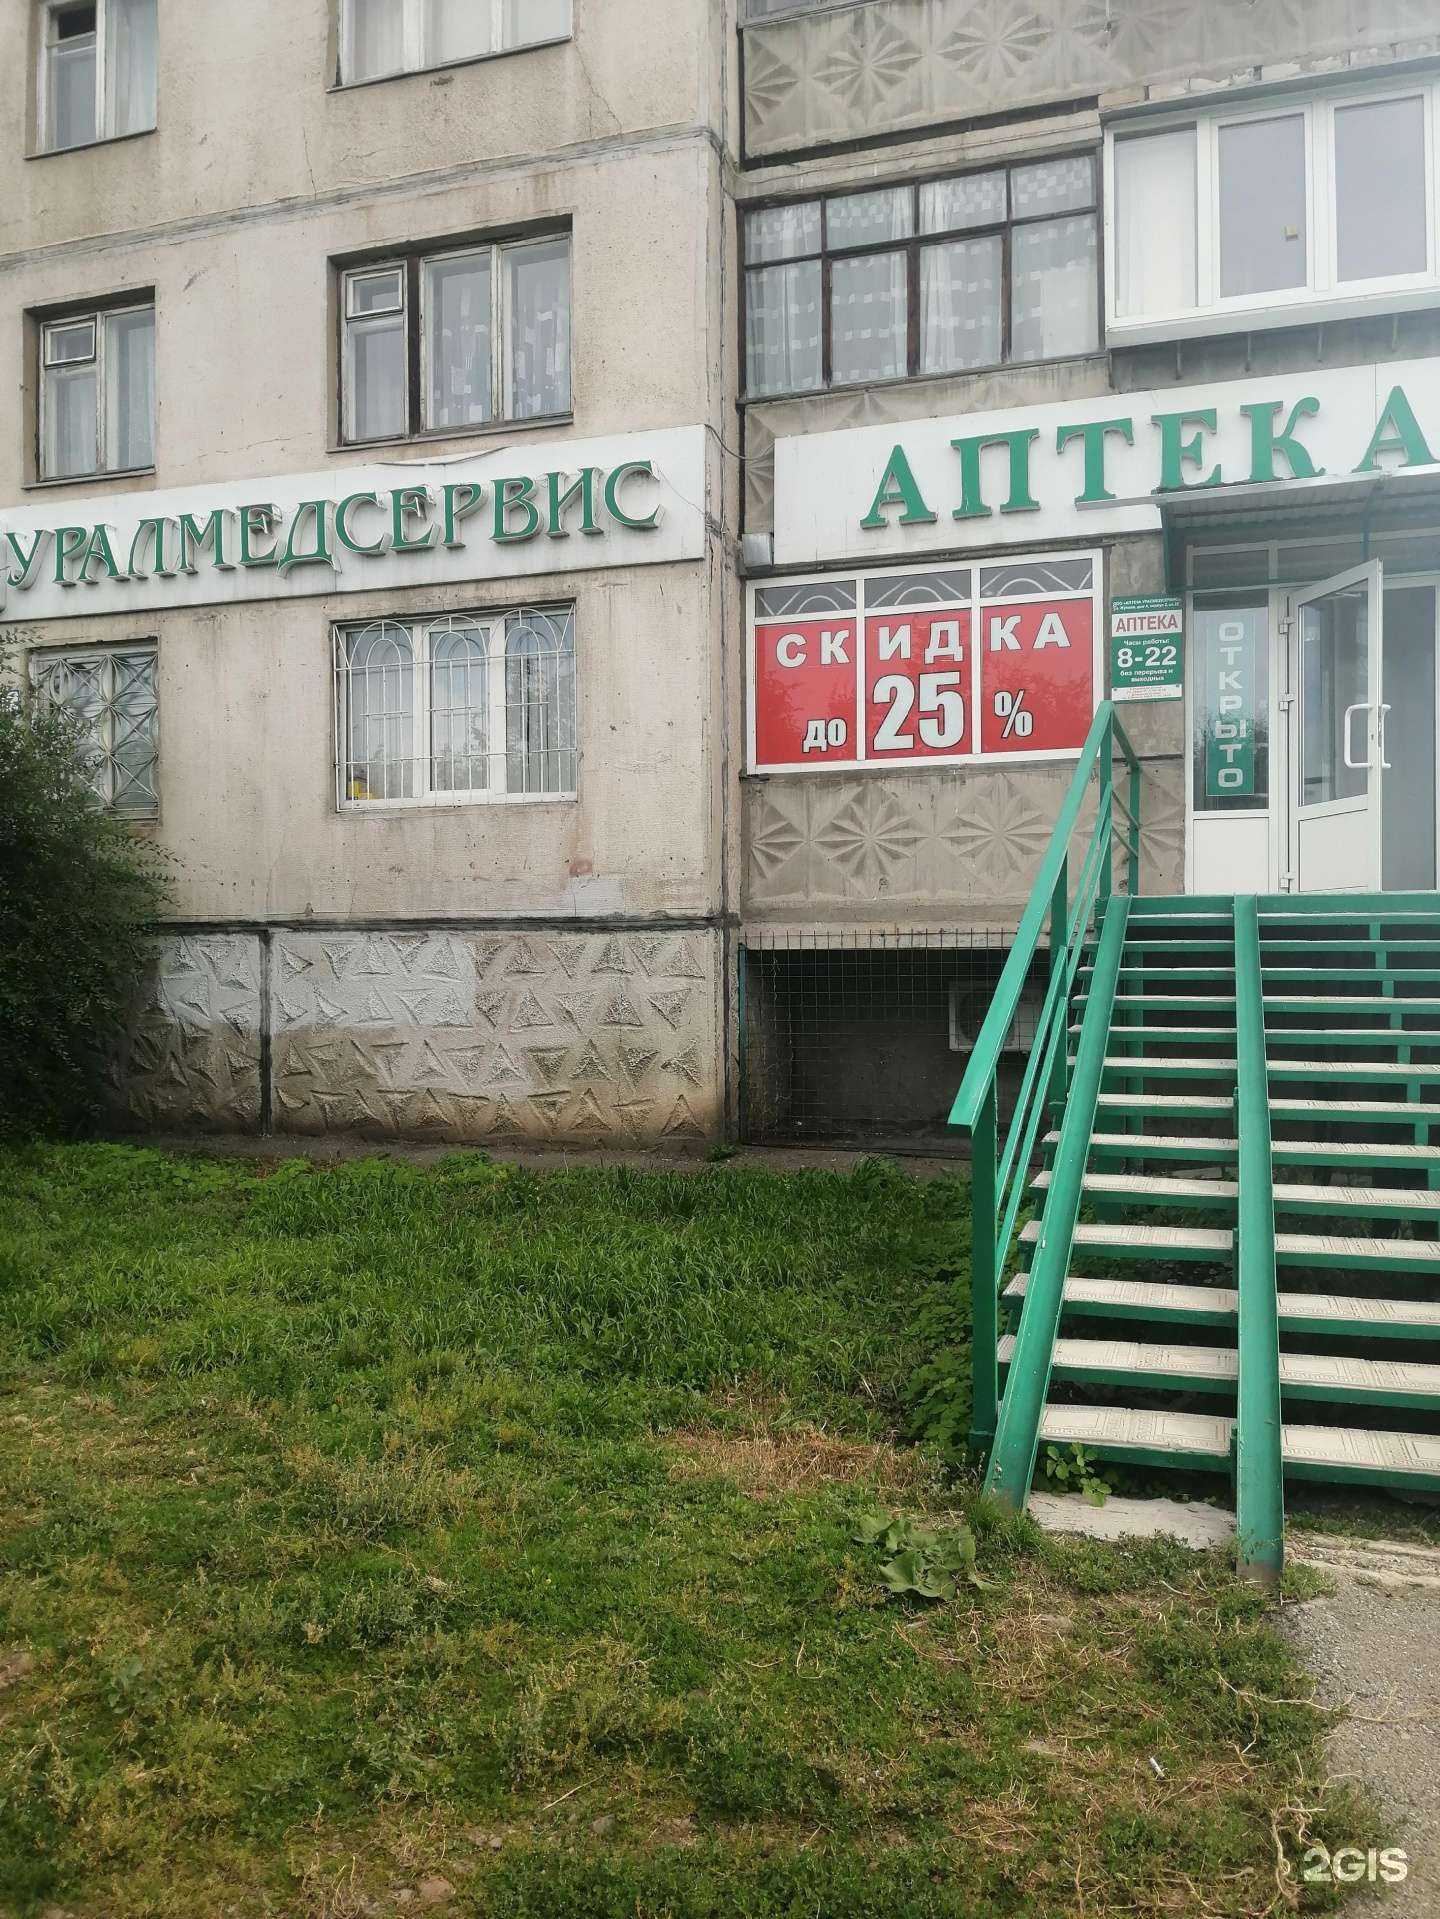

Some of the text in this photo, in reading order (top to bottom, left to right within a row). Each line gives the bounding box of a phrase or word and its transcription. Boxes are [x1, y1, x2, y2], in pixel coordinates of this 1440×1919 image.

[859, 384, 1440, 530] АПТЕКА
[4, 458, 669, 590] УРАЛМЕДСЕРВИС
[775, 612, 1071, 668] СКИДКА
[1115, 614, 1178, 632] АПТЕКА
[1117, 645, 1177, 668] 8-22
[872, 671, 965, 751] 25
[993, 689, 1034, 739] %
[1215, 622, 1247, 788] ОТКРЫТО
